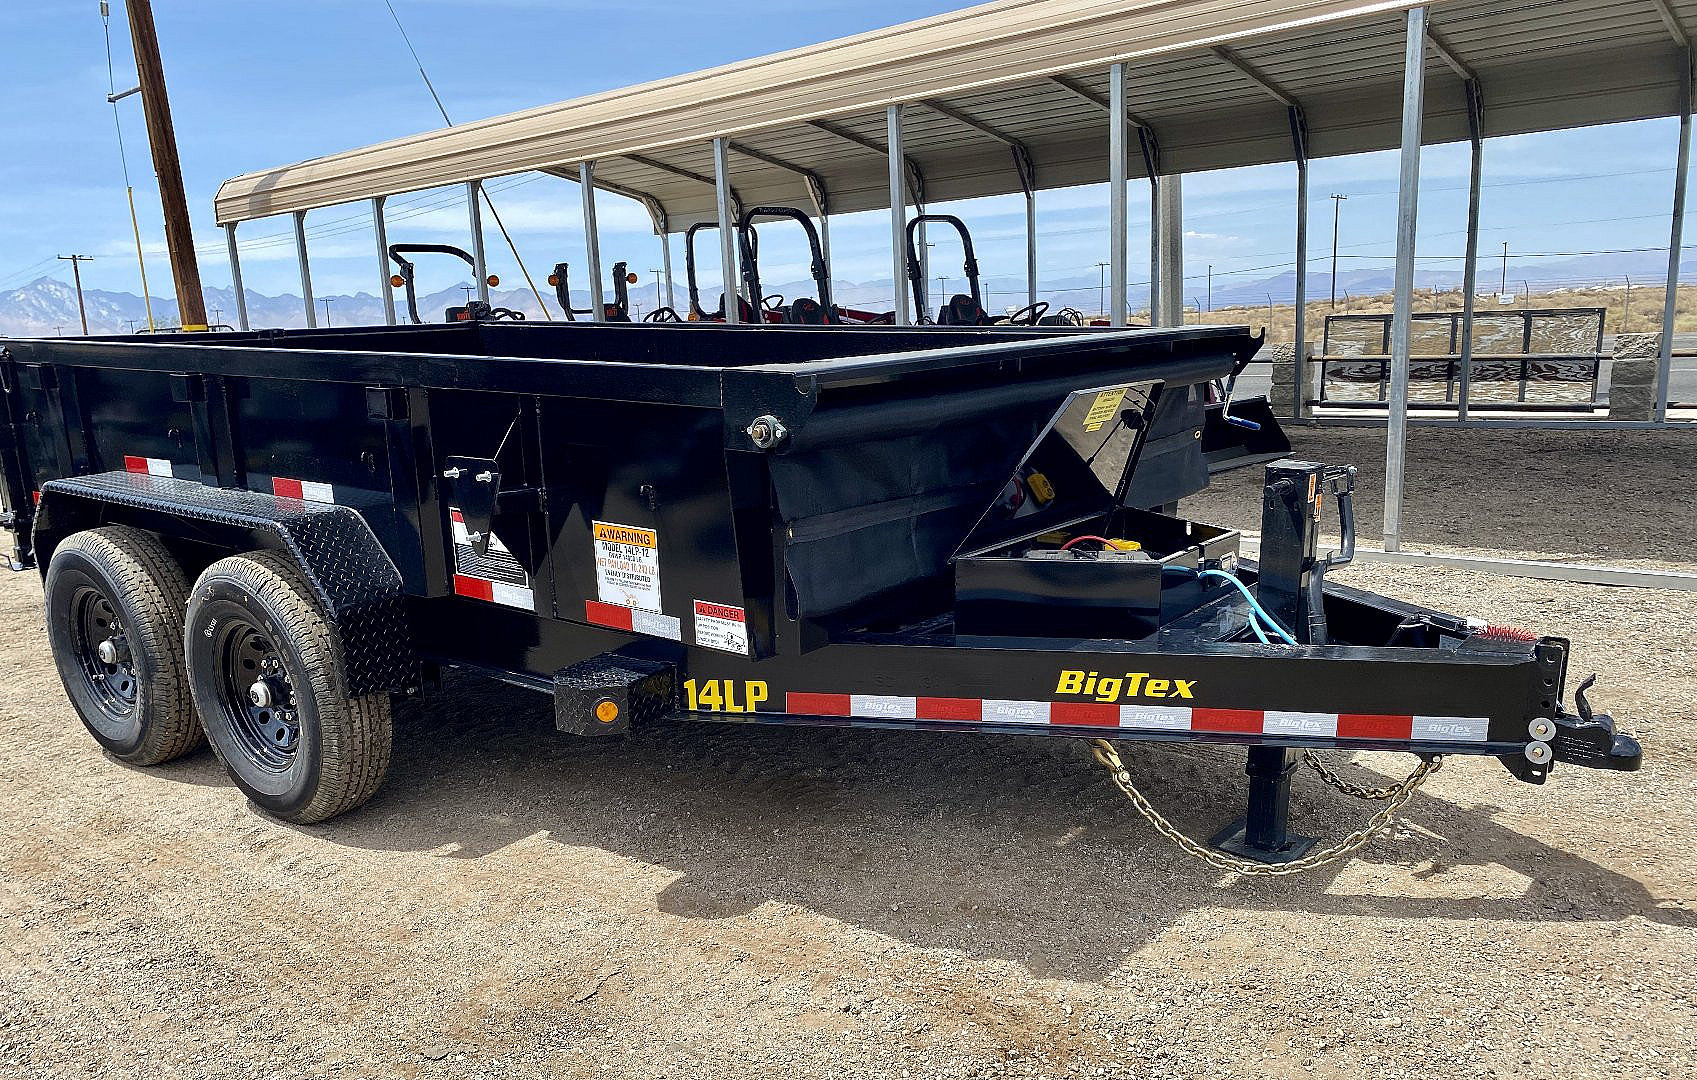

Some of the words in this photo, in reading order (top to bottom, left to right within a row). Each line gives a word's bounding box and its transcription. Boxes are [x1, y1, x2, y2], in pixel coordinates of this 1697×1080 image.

[607, 529, 650, 545] WARNING
[602, 542, 622, 553] MODEL
[624, 545, 650, 558] 14LP-12
[708, 606, 739, 619] DANGER
[1054, 669, 1198, 702] BigTex
[683, 678, 769, 714] 14LP
[996, 705, 1037, 716] BigTex
[1134, 712, 1177, 723] BigTex
[1278, 718, 1323, 730] BigTex
[1428, 723, 1473, 735] BigTex
